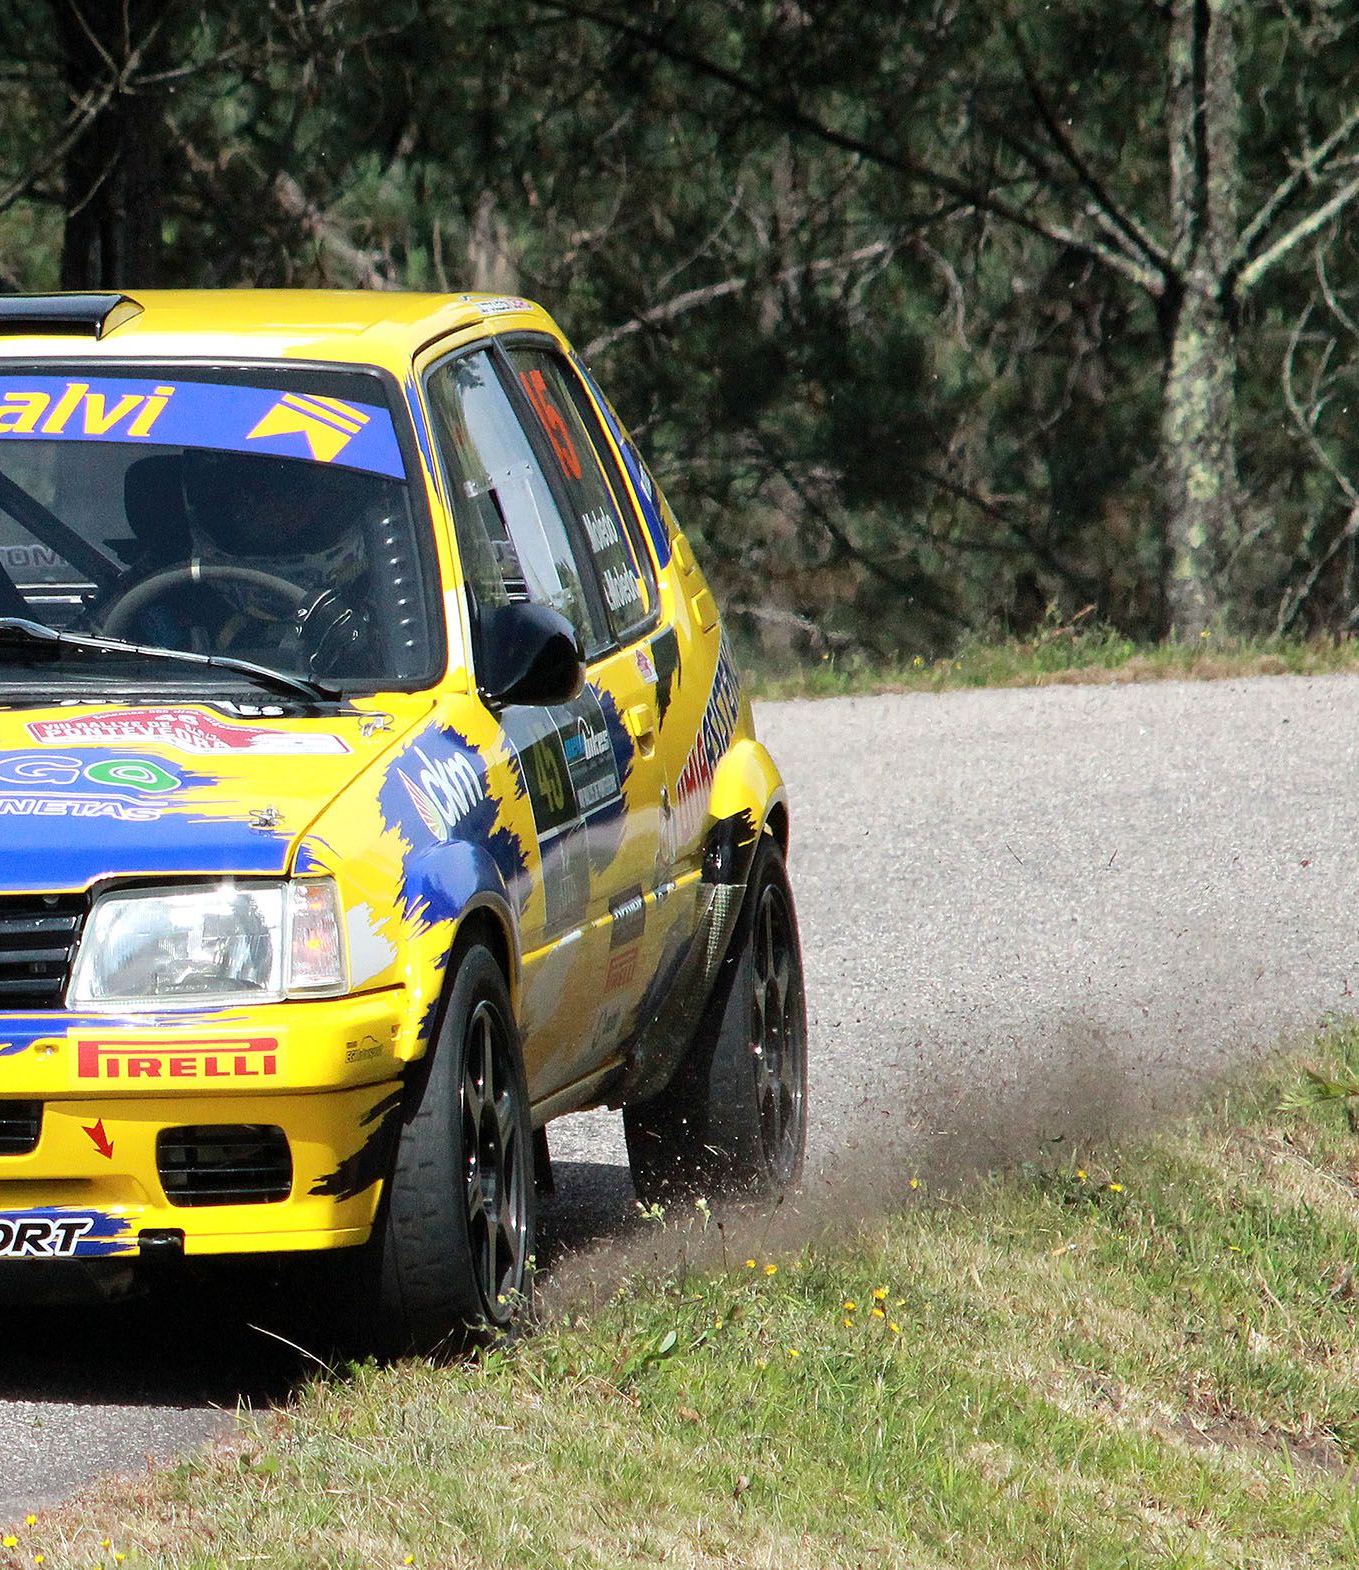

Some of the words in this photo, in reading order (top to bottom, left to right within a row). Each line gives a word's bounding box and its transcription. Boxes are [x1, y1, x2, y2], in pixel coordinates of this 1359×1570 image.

[44, 725, 232, 749] PONTEVEDRA
[531, 727, 565, 814] 45
[78, 1037, 279, 1078] PIRELLI
